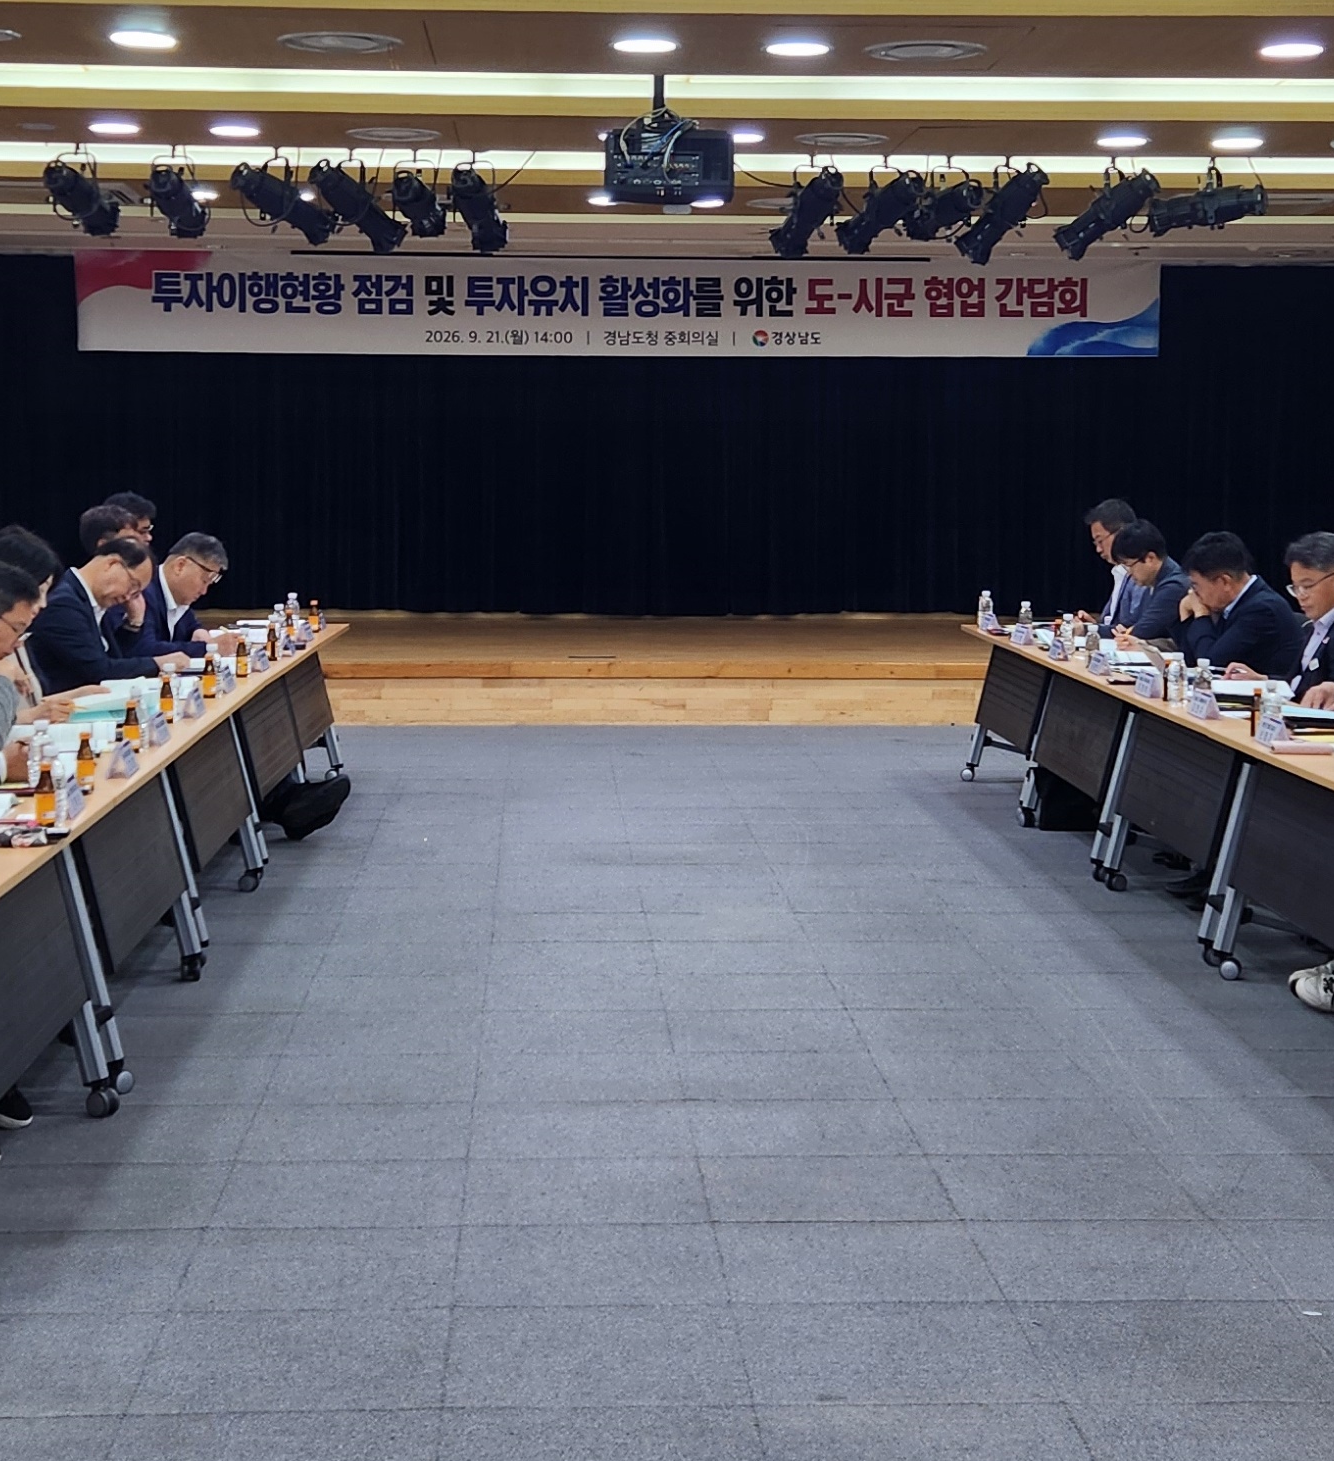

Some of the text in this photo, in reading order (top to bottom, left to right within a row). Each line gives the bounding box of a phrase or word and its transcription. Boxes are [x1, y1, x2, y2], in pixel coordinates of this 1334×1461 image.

[151, 271, 1089, 319] 투자이행현황 점검 및 투자유치 활성화를 위한 도-시군 협업 간담회
[425, 329, 821, 347] 2026. 9. 21.(월) 14:00 경남도청 중회의실 경상남도
